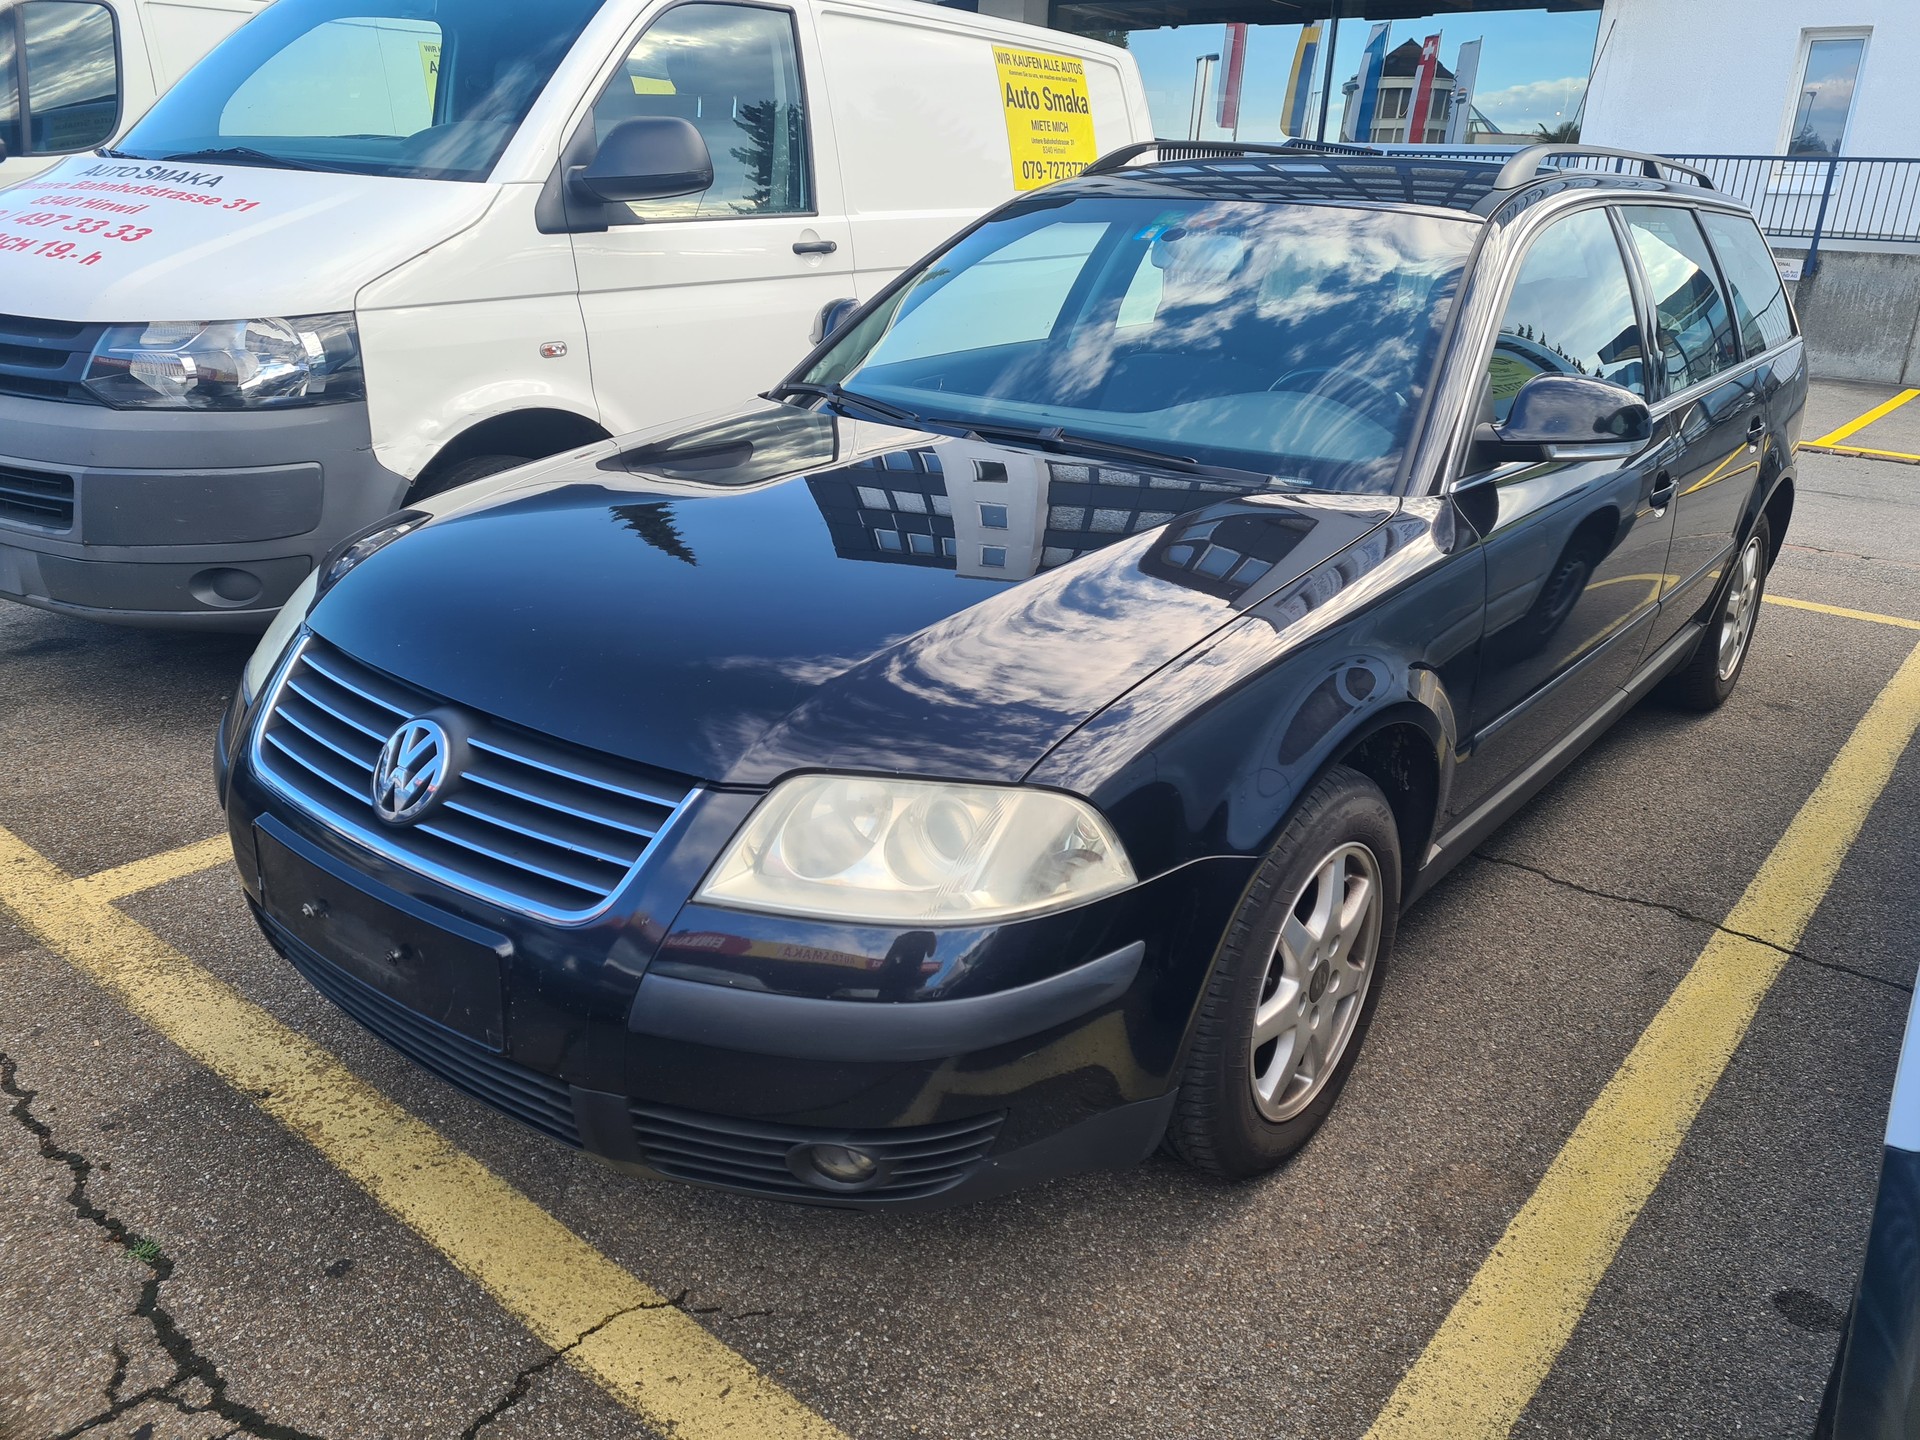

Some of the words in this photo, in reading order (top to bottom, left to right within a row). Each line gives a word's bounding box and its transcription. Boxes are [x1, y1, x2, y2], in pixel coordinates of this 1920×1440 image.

[424, 45, 437, 53] WIR
[996, 52, 1011, 65] WIR
[1012, 54, 1042, 70] KAUFEN
[1043, 59, 1060, 72] ALLE
[1061, 61, 1083, 75] AUTOS
[1006, 82, 1040, 110] Auto
[1042, 86, 1089, 114] Smaka
[1031, 119, 1051, 132] MIETE
[1051, 121, 1069, 133] MICH
[75, 163, 141, 178] AUTO
[136, 165, 225, 188] SMAKA
[30, 195, 84, 206] 8340
[75, 198, 151, 215] Hinwil
[67, 180, 223, 206] Bahnhofstrasse
[222, 198, 261, 213] 31
[13, 212, 74, 227] 497
[63, 218, 111, 233] 33
[103, 224, 152, 241] 33
[78, 251, 103, 266] h
[373, 718, 450, 823] VW
